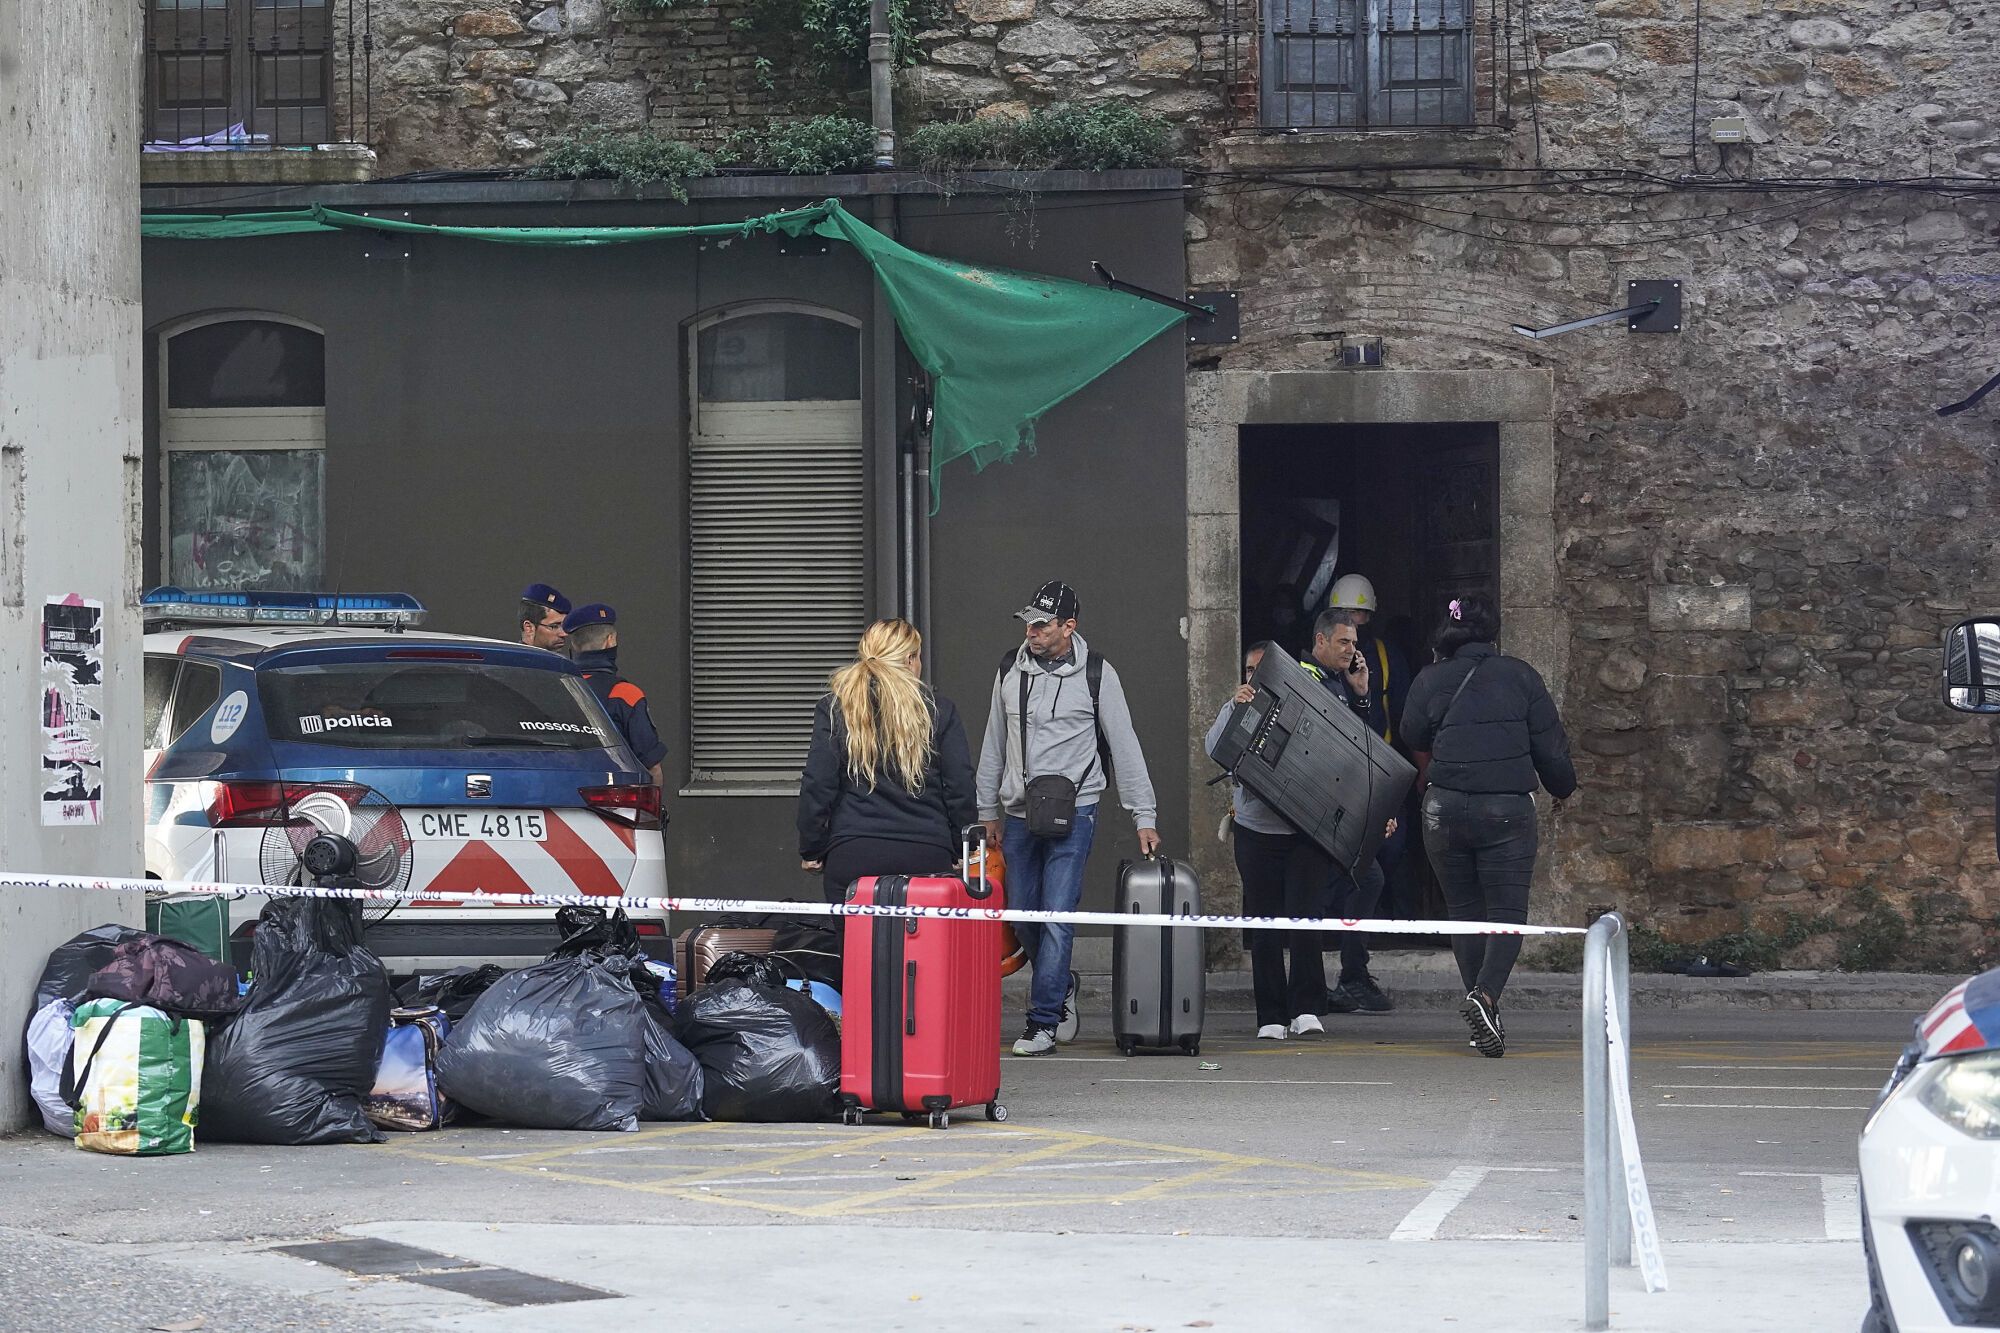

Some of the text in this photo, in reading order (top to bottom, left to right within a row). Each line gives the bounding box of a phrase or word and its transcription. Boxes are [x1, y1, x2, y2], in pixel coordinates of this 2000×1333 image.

[1357, 344, 1367, 364] 1
[218, 704, 242, 723] 112
[325, 714, 392, 731] policia
[519, 721, 607, 737] mossos.cat
[421, 814, 543, 838] CME 4815
